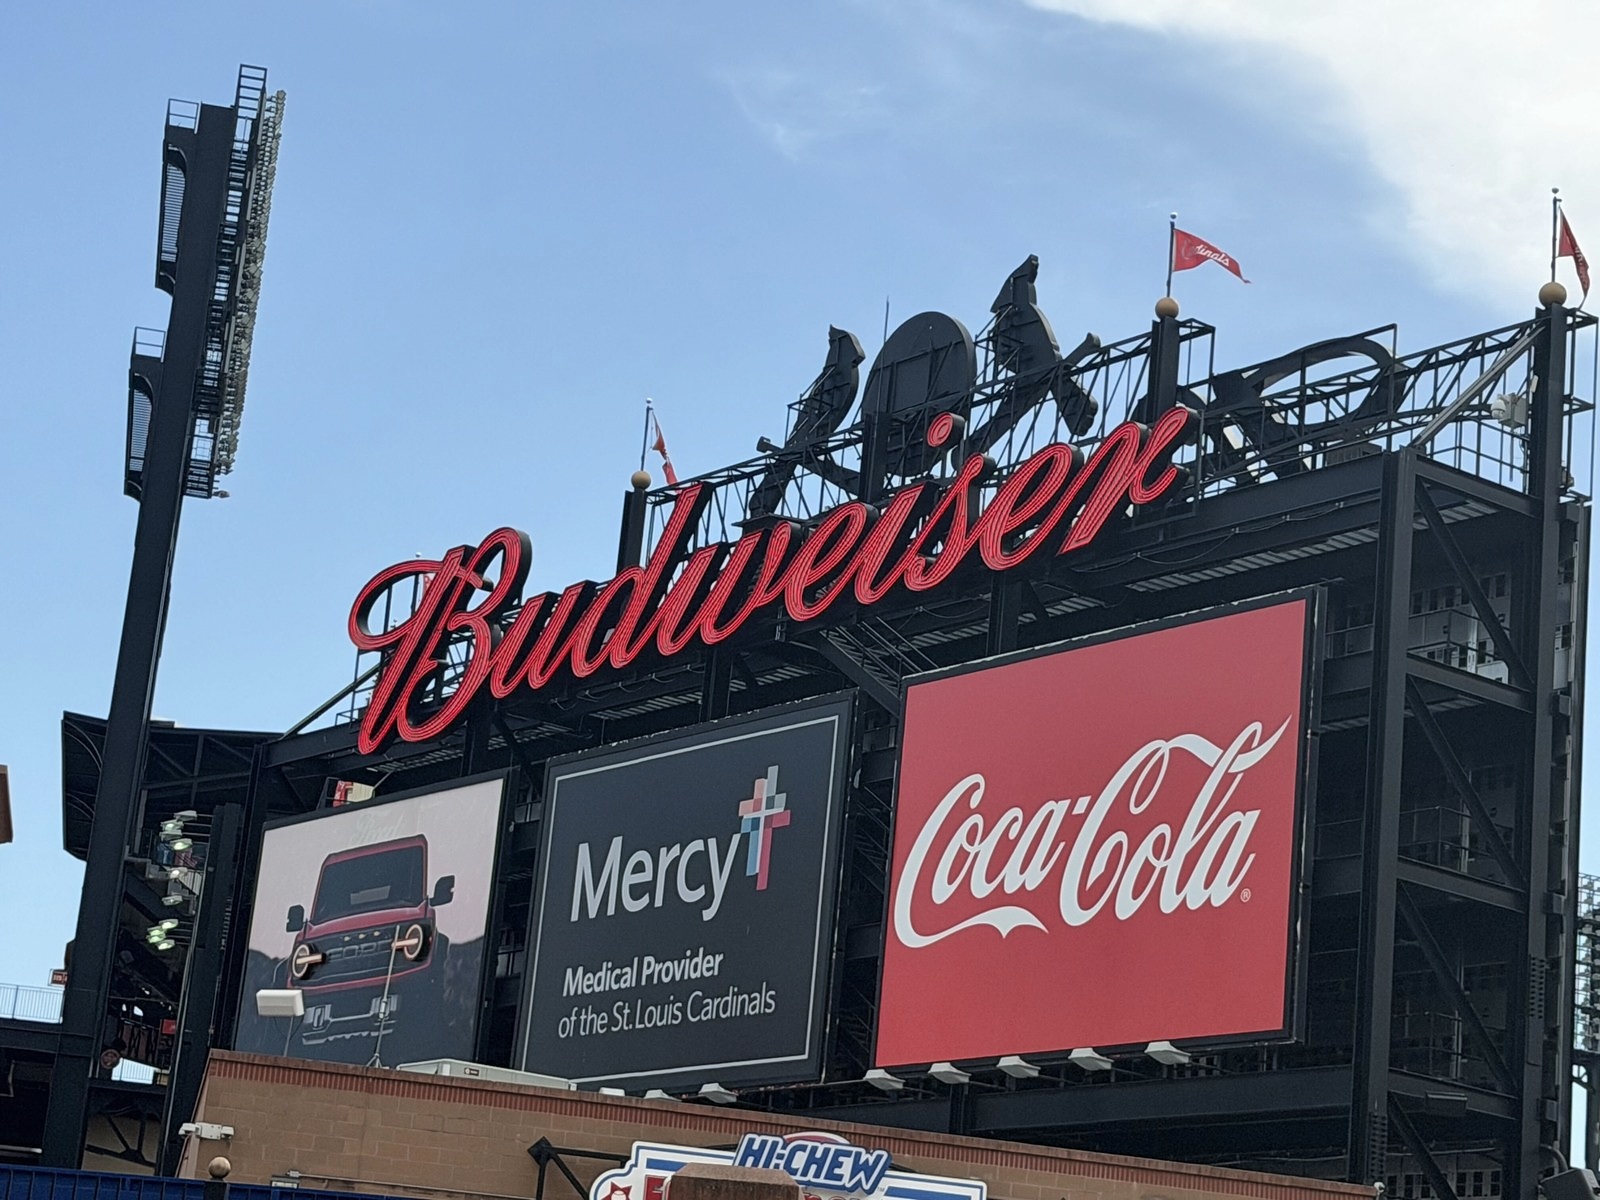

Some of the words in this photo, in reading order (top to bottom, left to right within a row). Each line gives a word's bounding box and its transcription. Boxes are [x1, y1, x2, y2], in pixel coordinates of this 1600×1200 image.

[348, 406, 1194, 755] Budweiser
[894, 713, 1292, 948] Coca-Cola
[570, 833, 741, 922] Mercy
[558, 1007, 578, 1038] of
[579, 1005, 608, 1036] the
[686, 982, 776, 1023] Cardinals
[562, 956, 638, 997] Medical
[640, 947, 724, 986] Provider
